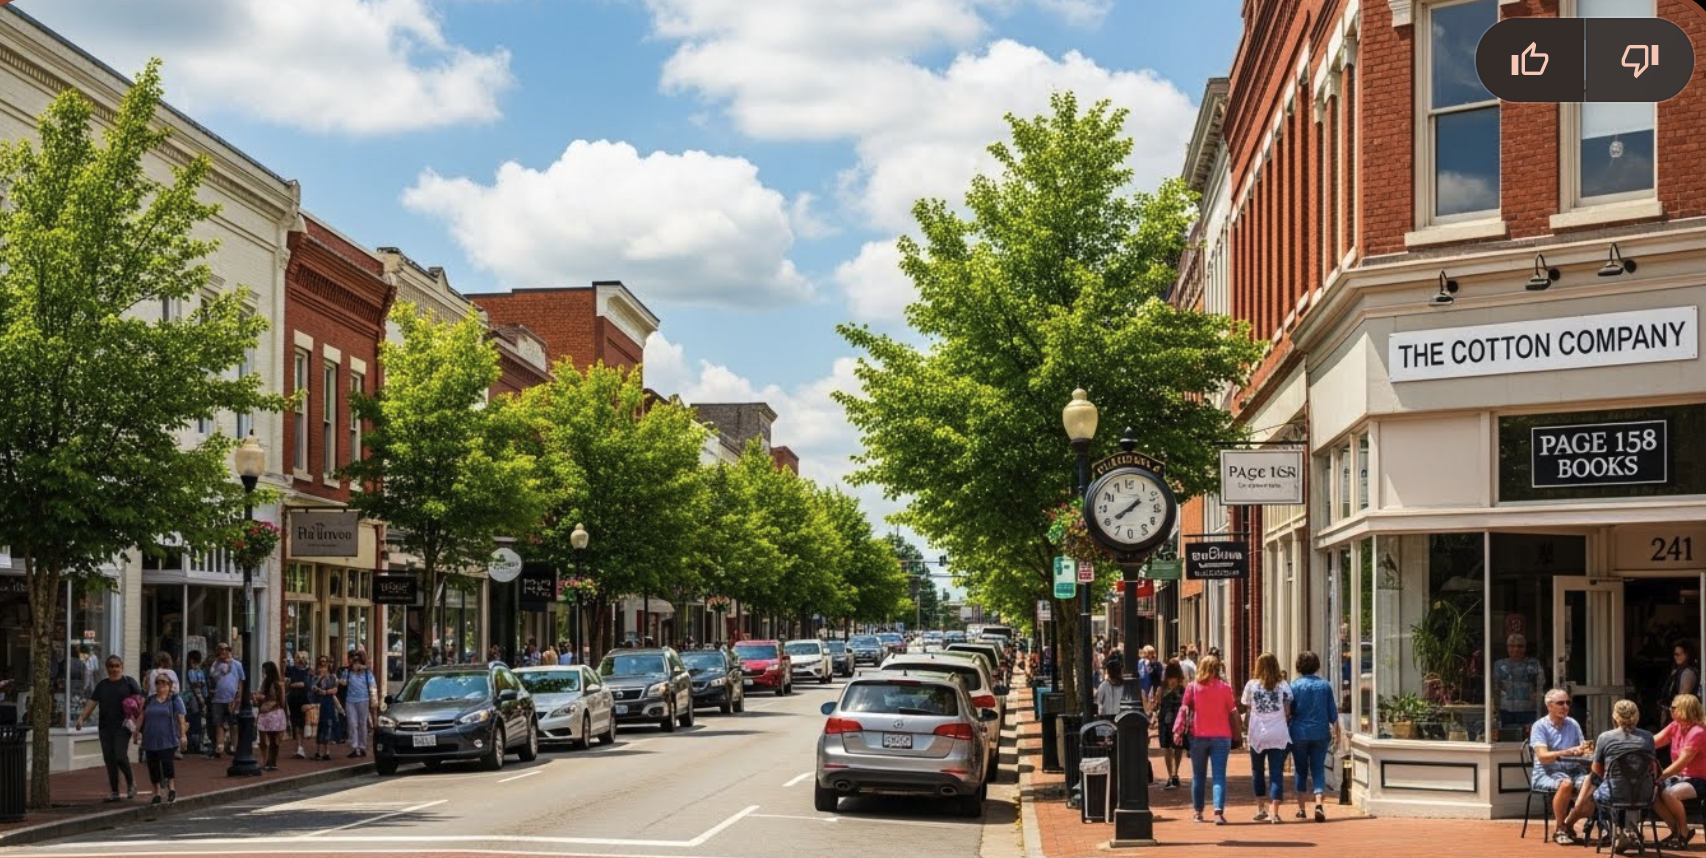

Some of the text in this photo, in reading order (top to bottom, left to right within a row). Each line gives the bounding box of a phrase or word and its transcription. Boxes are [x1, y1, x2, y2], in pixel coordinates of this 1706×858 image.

[1399, 320, 1686, 369] THE COTTON COMPANY
[1539, 428, 1657, 455] PAGE 158
[1557, 455, 1638, 478] BOOKS
[1650, 536, 1693, 561] 241
